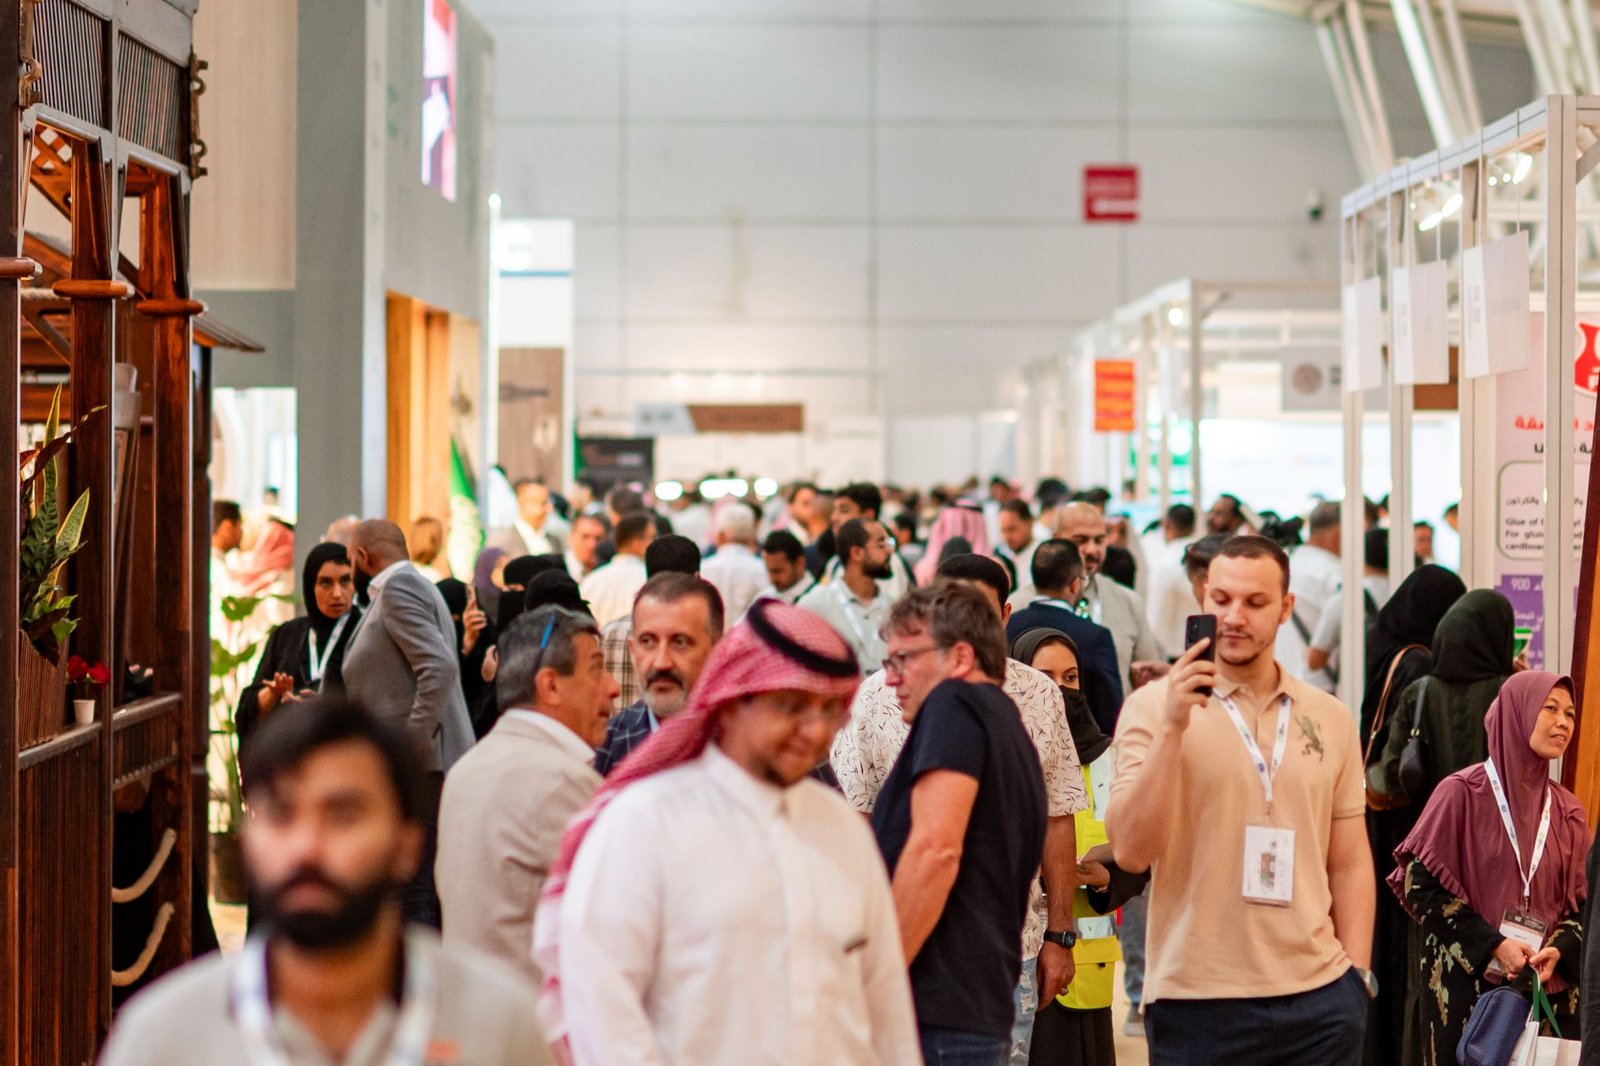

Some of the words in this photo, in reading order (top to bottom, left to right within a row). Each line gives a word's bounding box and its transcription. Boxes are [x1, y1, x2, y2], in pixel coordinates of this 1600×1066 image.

[1505, 518, 1526, 526] Glue
[1529, 518, 1538, 526] of
[1505, 530, 1519, 538] For
[1511, 577, 1531, 591] 900
